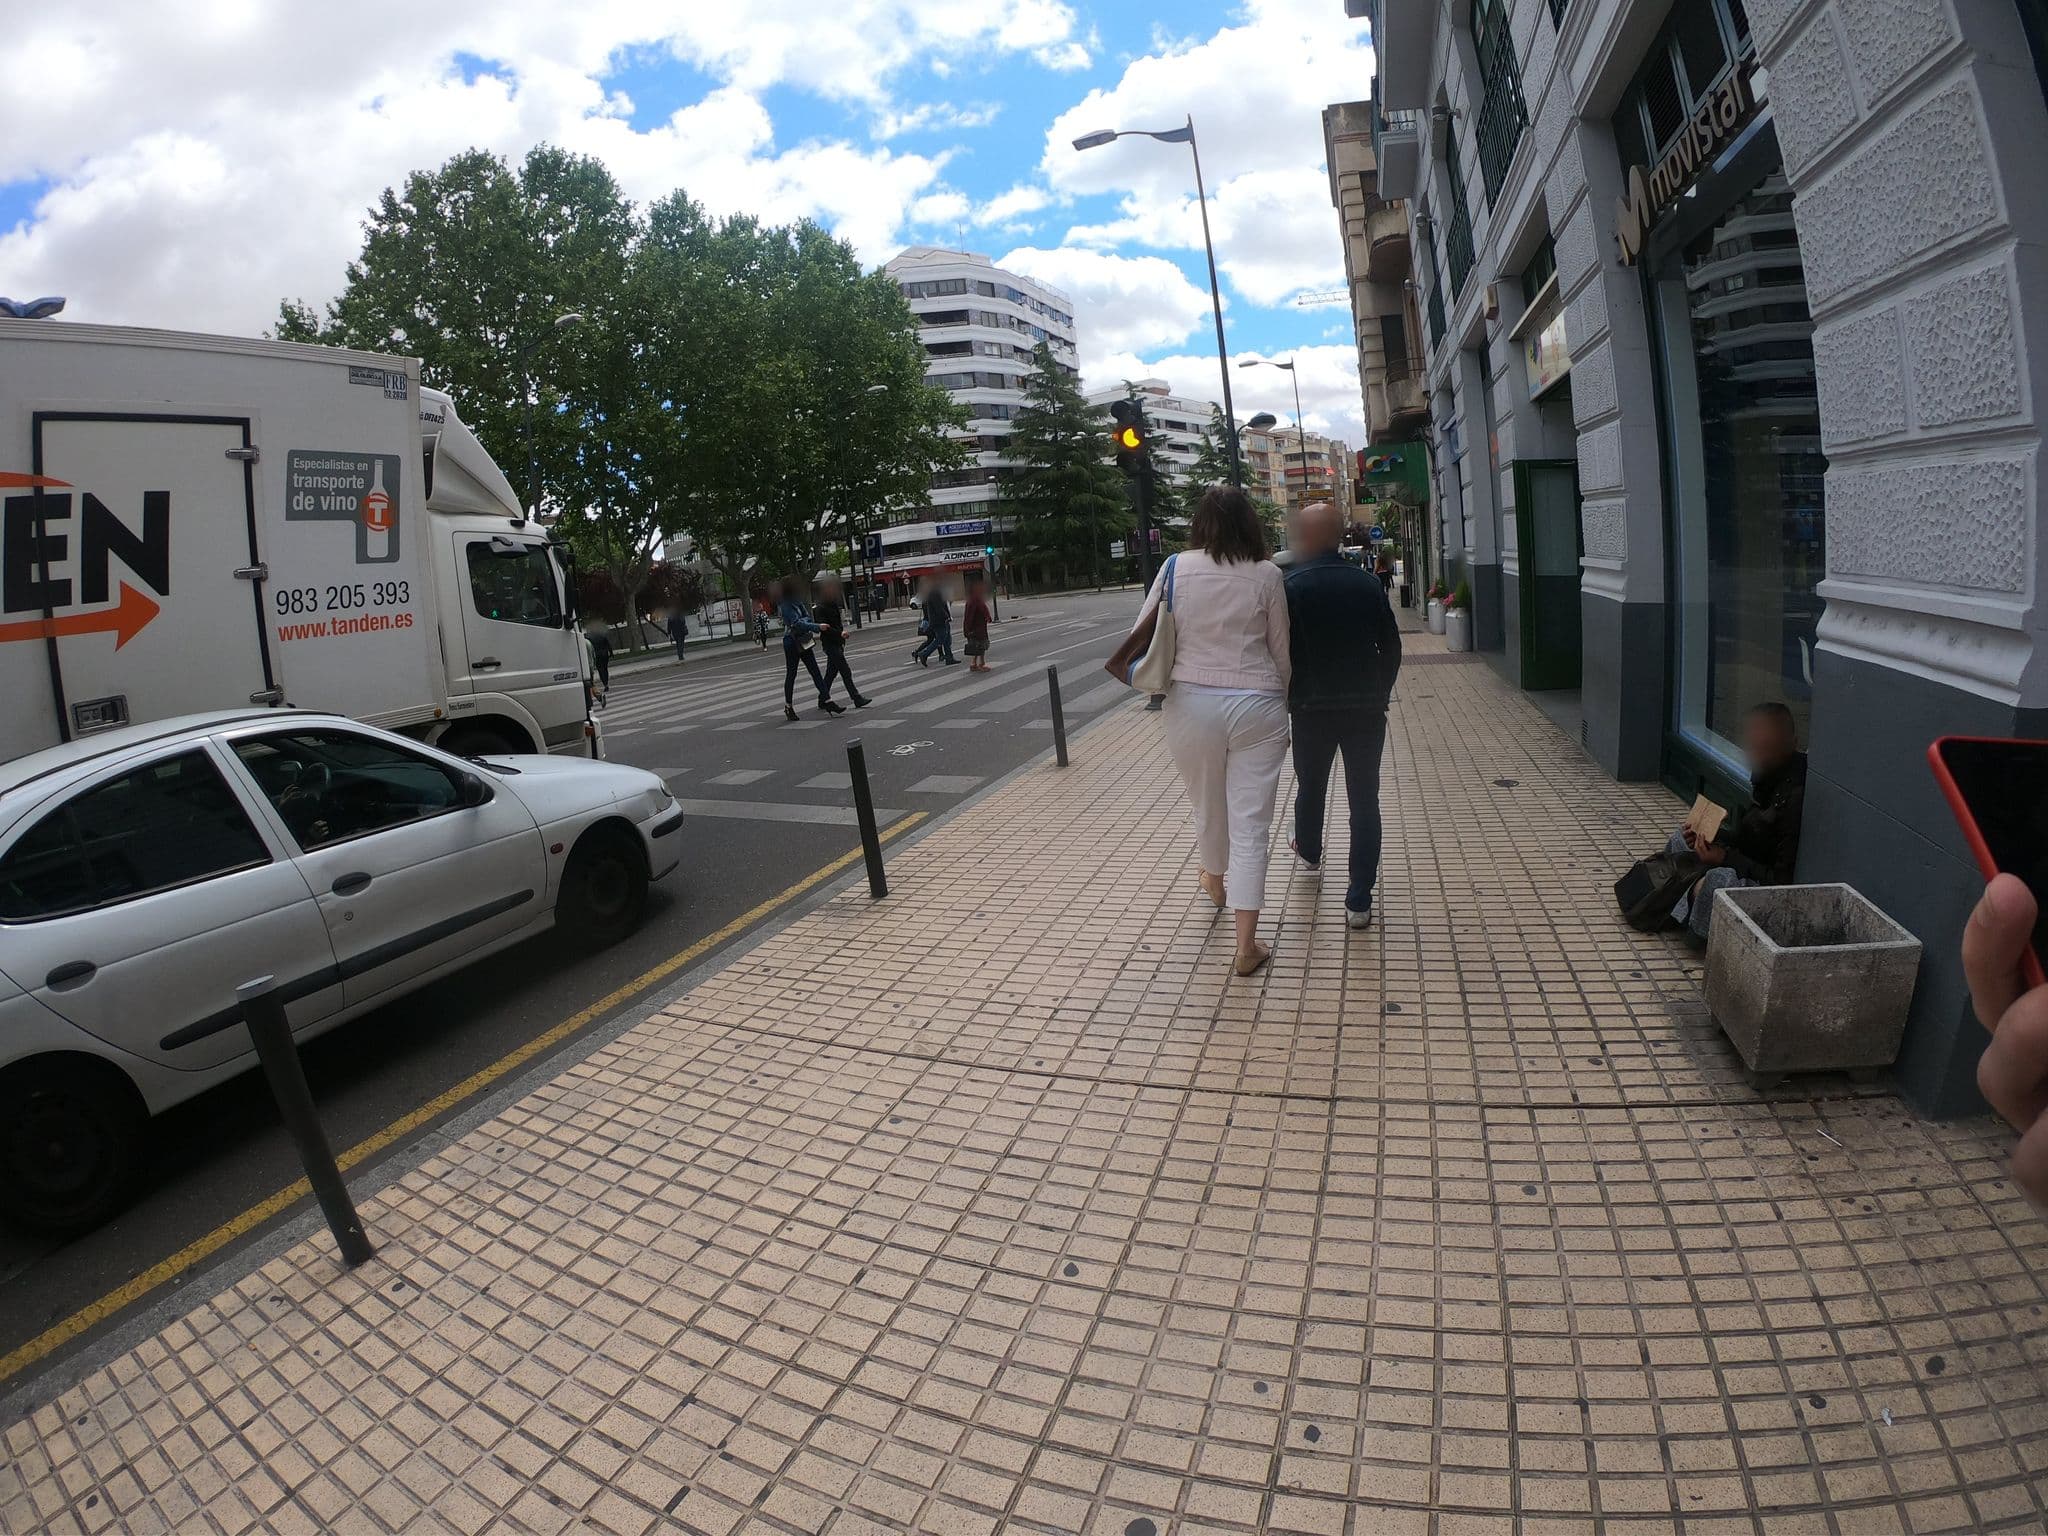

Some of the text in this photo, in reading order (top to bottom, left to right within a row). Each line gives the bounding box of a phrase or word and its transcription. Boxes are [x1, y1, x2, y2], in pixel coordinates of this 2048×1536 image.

[1649, 63, 1746, 212] movistar
[293, 457, 369, 471] Especialistas en
[292, 472, 365, 491] transporte
[292, 491, 357, 511] de vino
[3, 490, 171, 614] EN
[865, 536, 876, 557] P
[944, 551, 980, 560] ADINCO
[276, 581, 410, 615] 983 205 393
[277, 612, 414, 642] www.tanden.es
